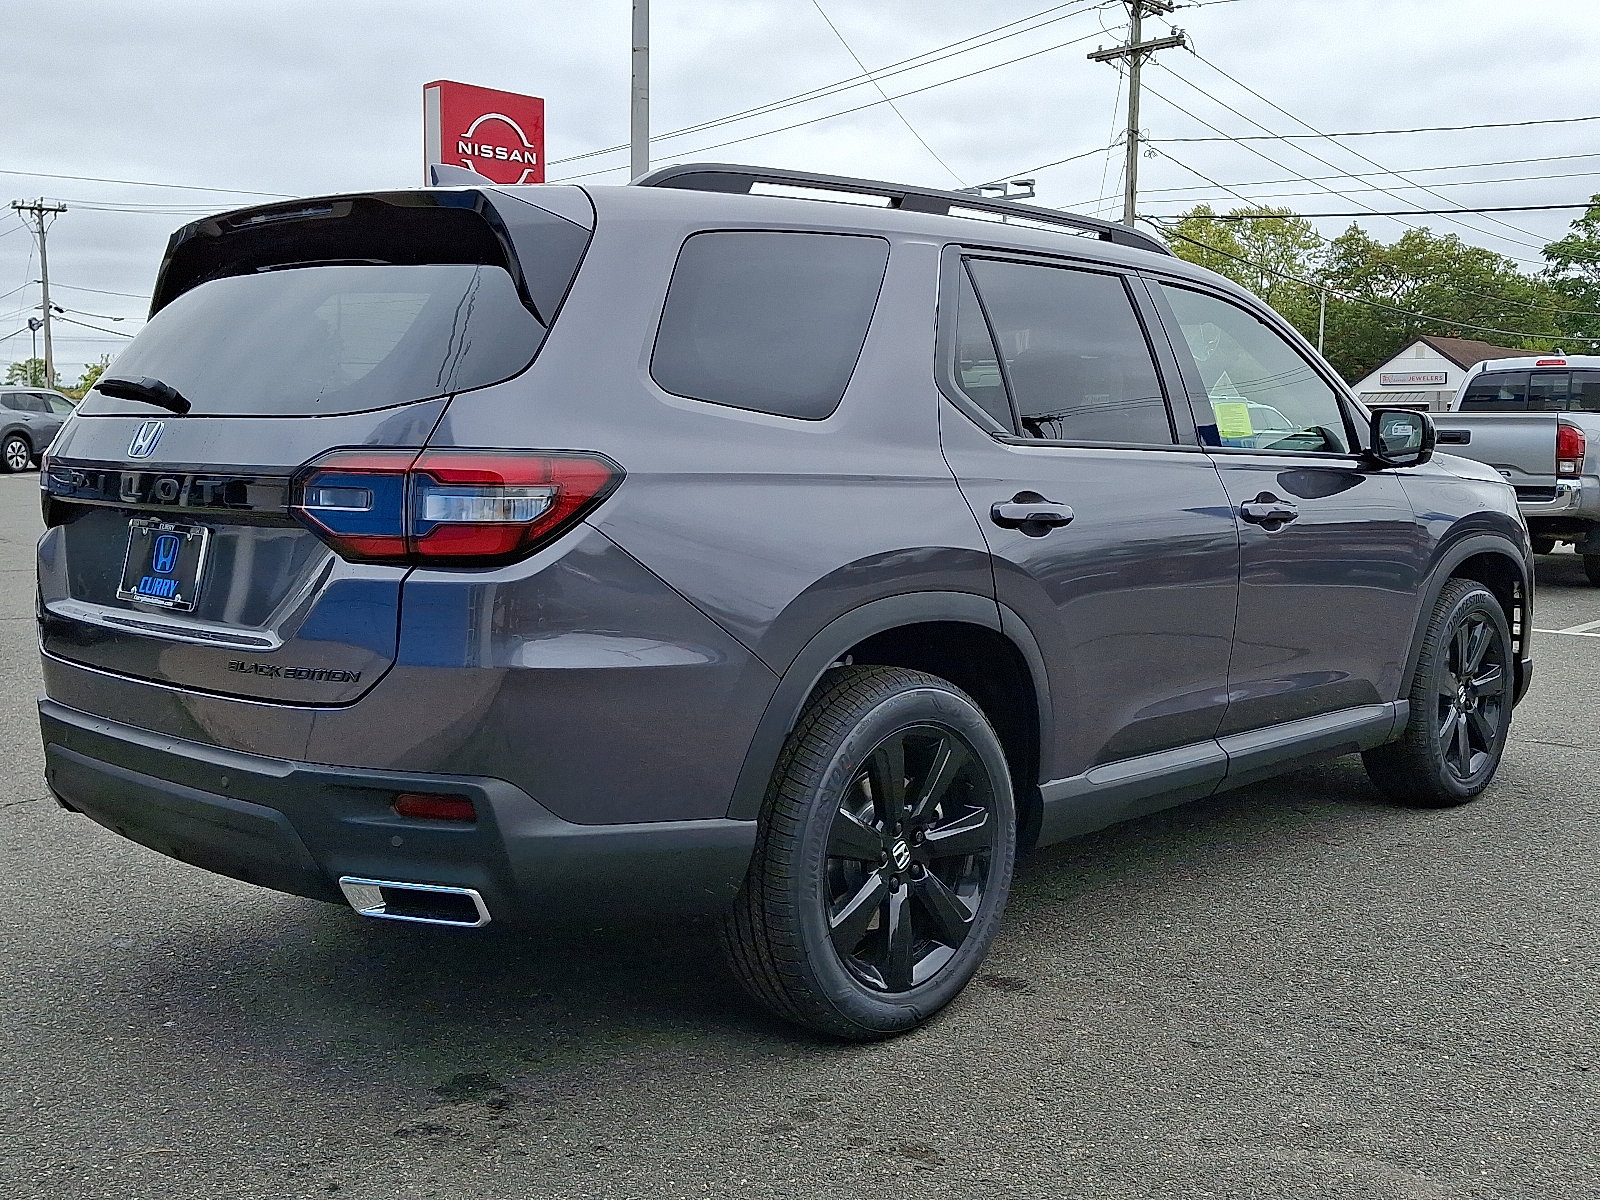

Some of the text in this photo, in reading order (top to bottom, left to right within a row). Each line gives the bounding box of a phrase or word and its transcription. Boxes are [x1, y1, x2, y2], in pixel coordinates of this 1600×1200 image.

[458, 140, 537, 165] NISSAN
[68, 469, 223, 503] PILOT
[159, 523, 176, 531] CURRY
[138, 576, 180, 598] CURRY
[227, 659, 362, 683] BLACK EDITION
